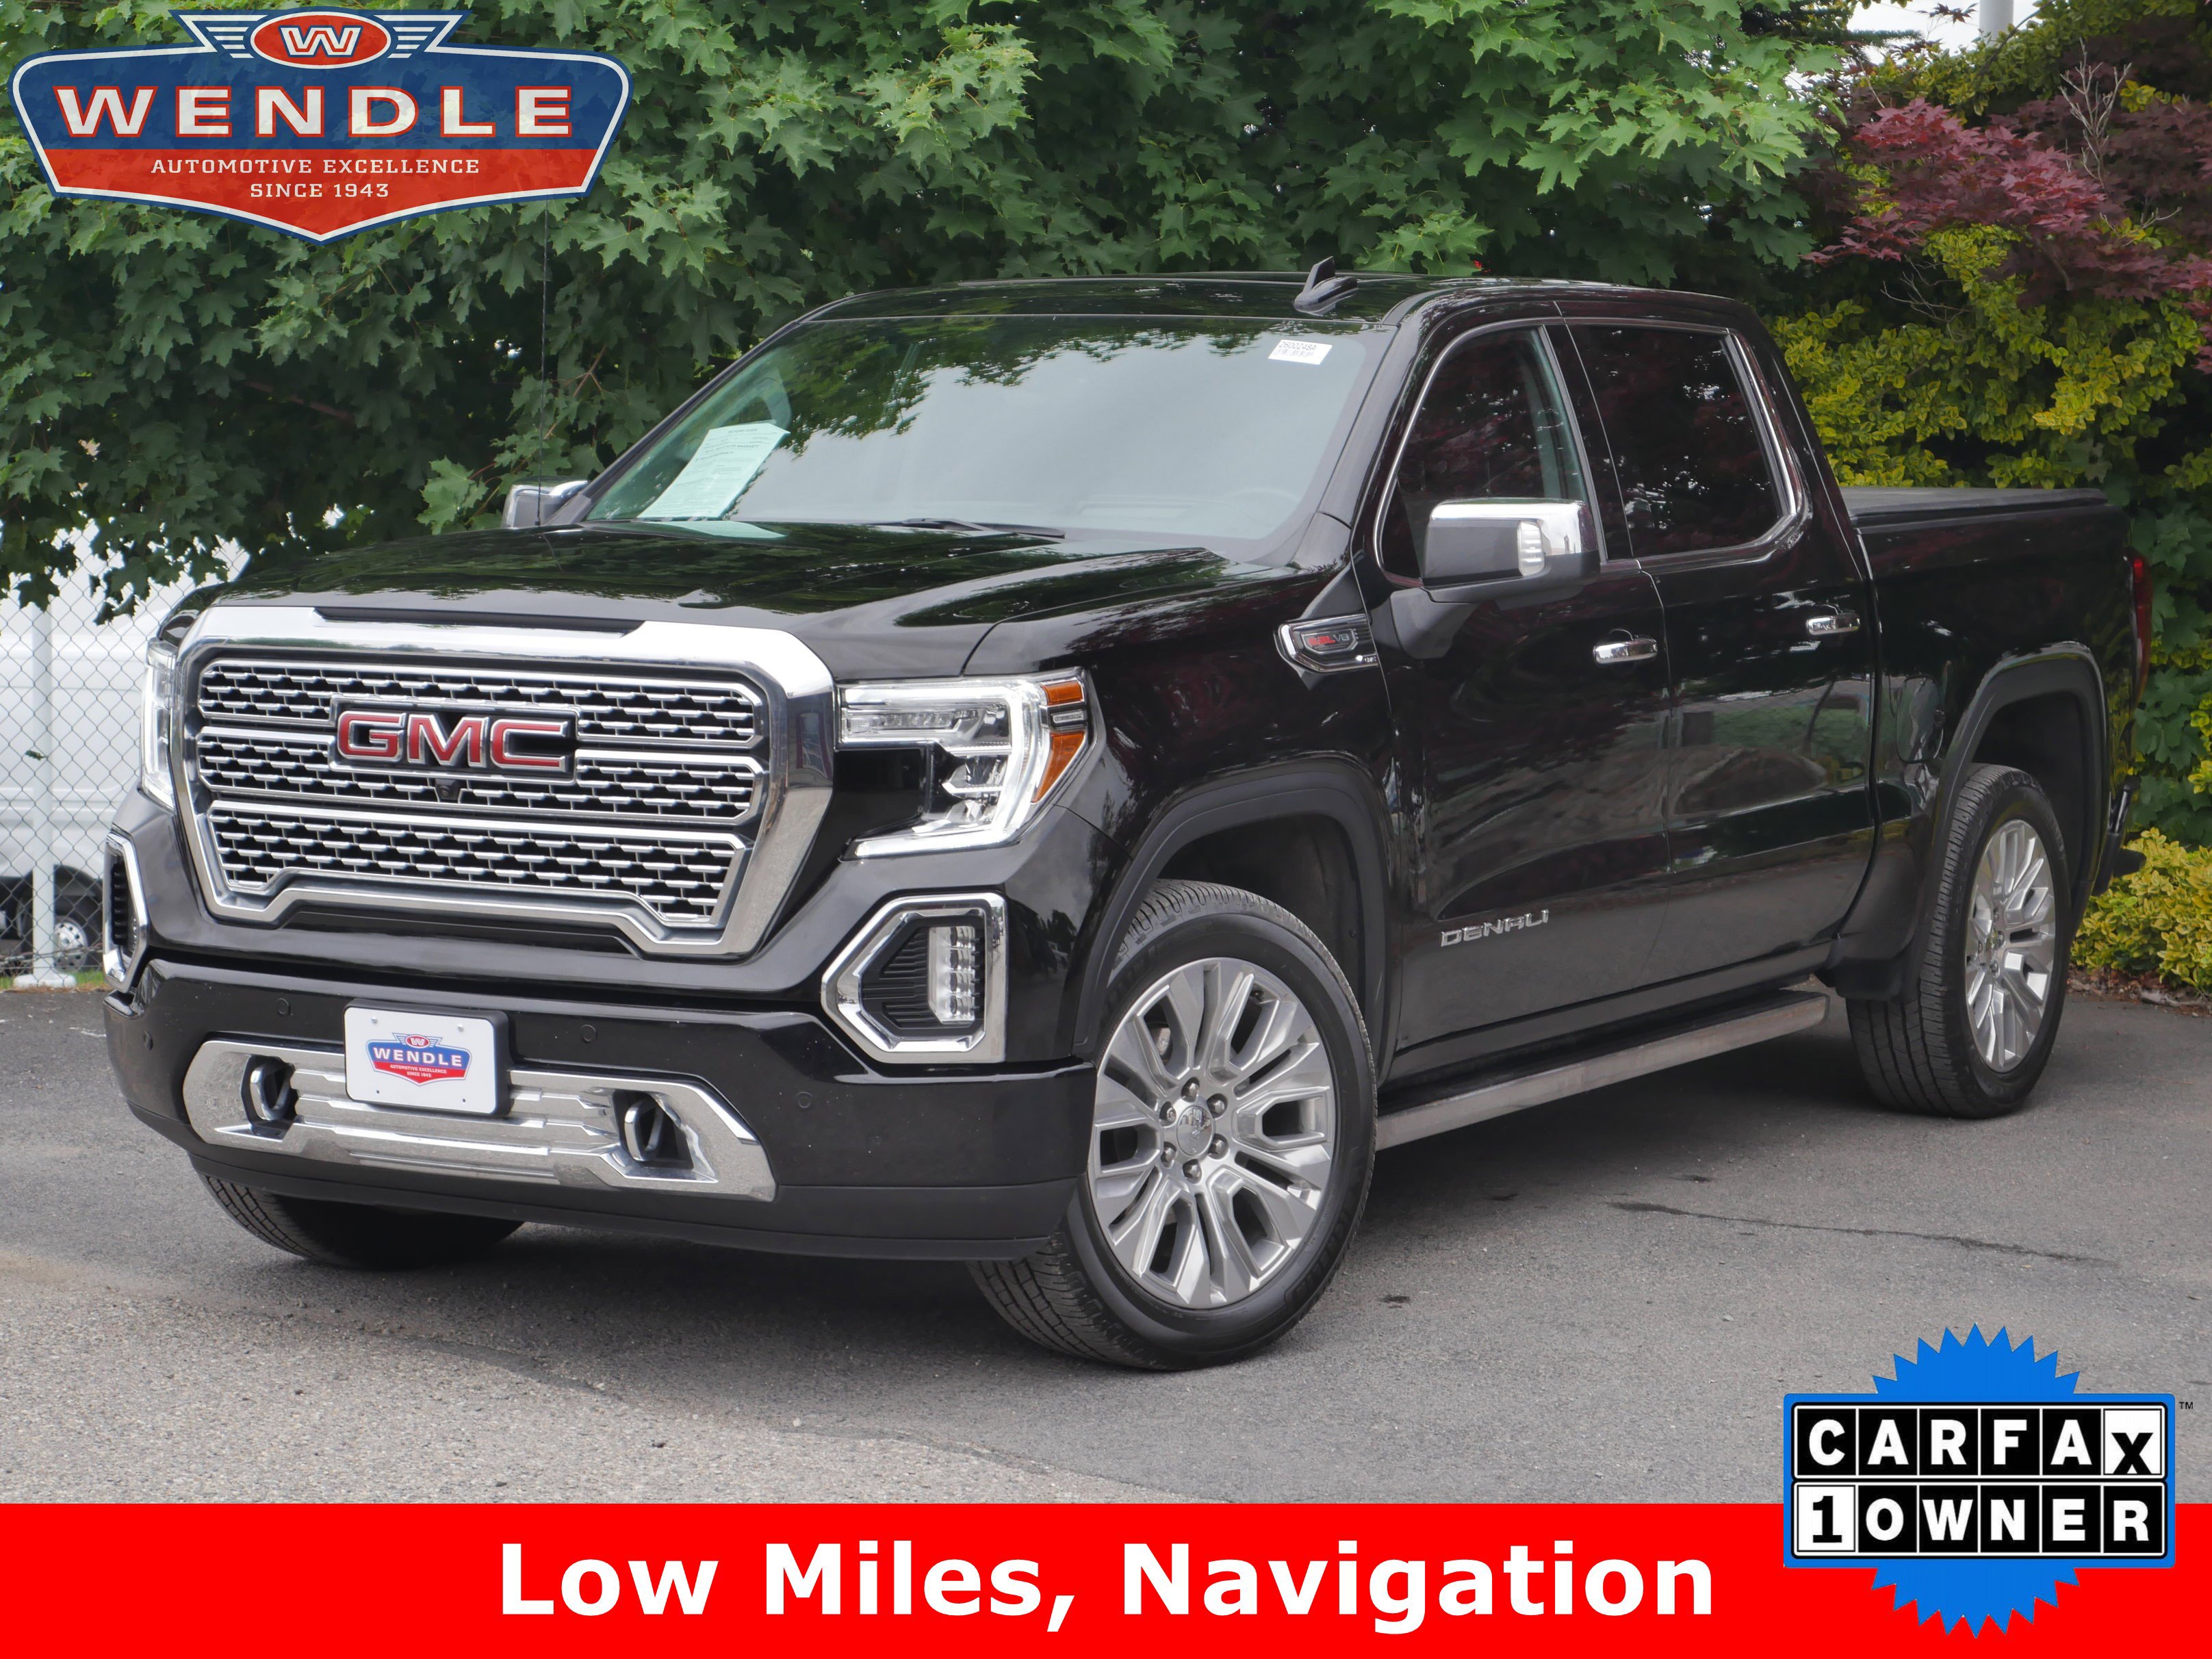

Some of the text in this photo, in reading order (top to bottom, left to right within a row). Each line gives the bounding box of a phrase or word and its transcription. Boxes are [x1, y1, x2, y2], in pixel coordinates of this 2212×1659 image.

[337, 710, 569, 772] GMC
[1441, 909, 1549, 947] DENALI
[372, 1046, 463, 1067] WENDLE
